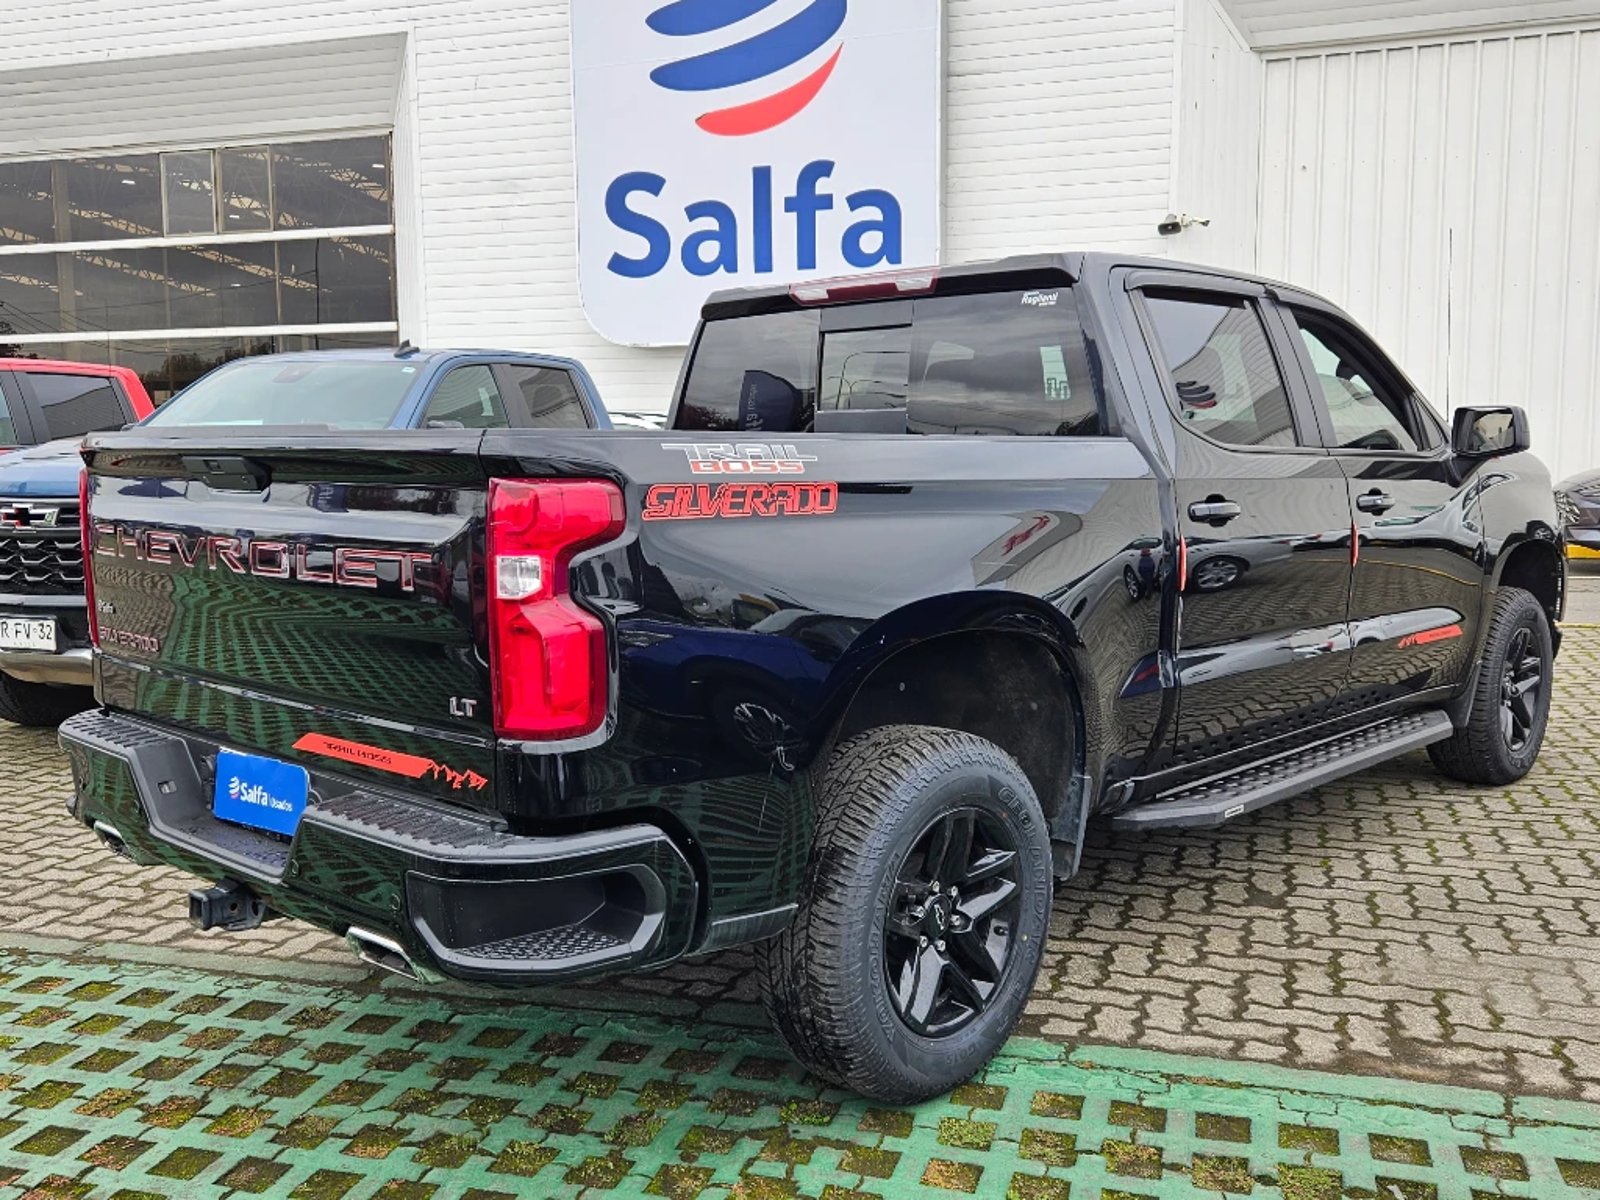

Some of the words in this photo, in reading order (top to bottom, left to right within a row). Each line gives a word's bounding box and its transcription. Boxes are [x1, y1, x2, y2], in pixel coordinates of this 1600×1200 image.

[604, 159, 902, 278] Salfa
[661, 443, 817, 461] TRAIL
[689, 460, 805, 474] BOSS
[642, 481, 838, 521] SILVERADO
[94, 524, 433, 591] CHEVROLET
[449, 696, 477, 718] LT
[240, 782, 268, 806] Salfa
